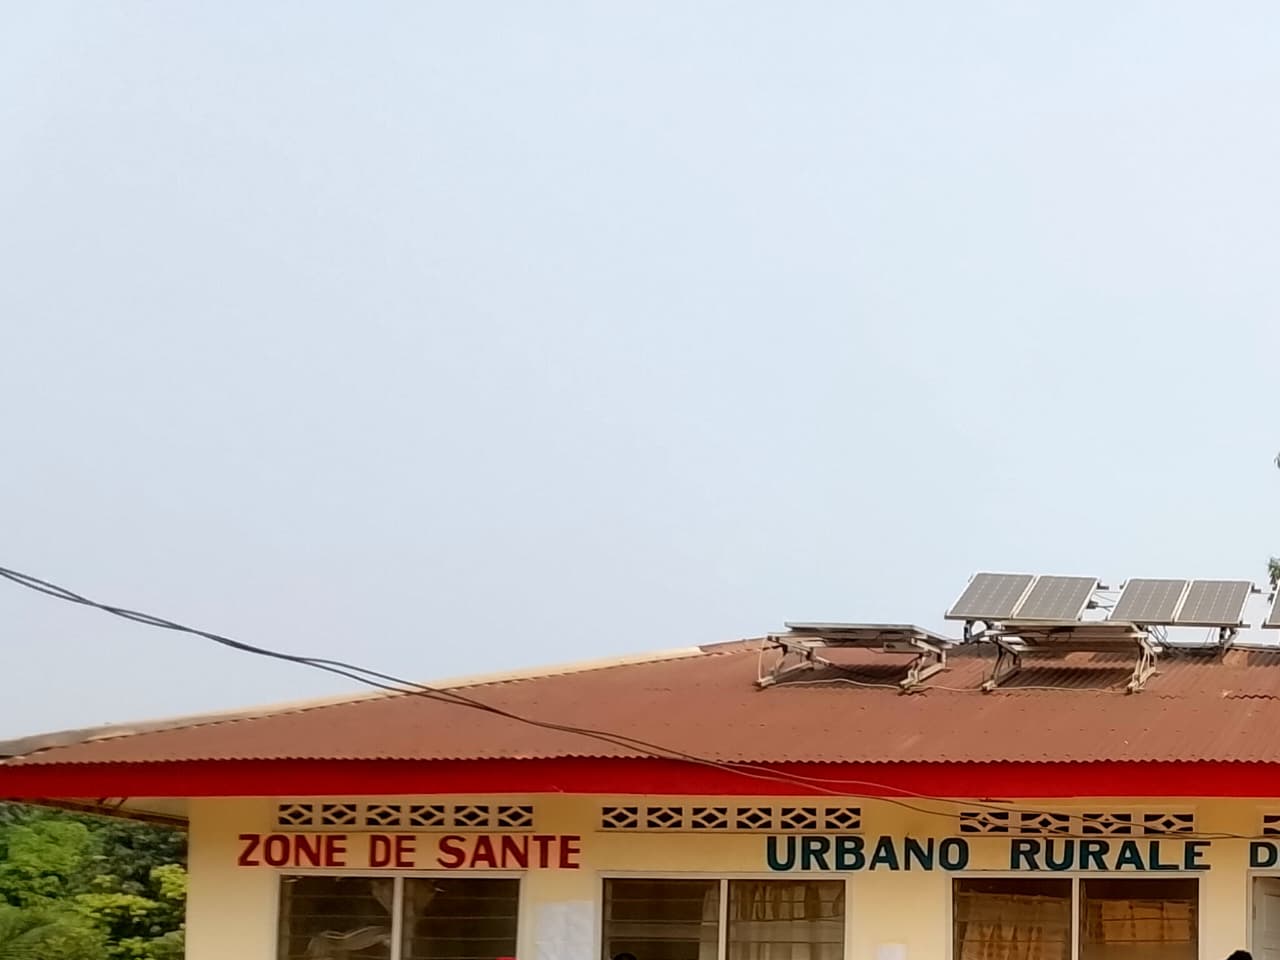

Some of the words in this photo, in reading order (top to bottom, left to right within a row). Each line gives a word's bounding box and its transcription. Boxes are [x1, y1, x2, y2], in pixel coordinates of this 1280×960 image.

[238, 833, 347, 867] ZONE
[369, 834, 416, 867] DE
[437, 834, 581, 868] SANTE
[766, 835, 969, 871] URBANO
[1011, 838, 1211, 870] RURALE
